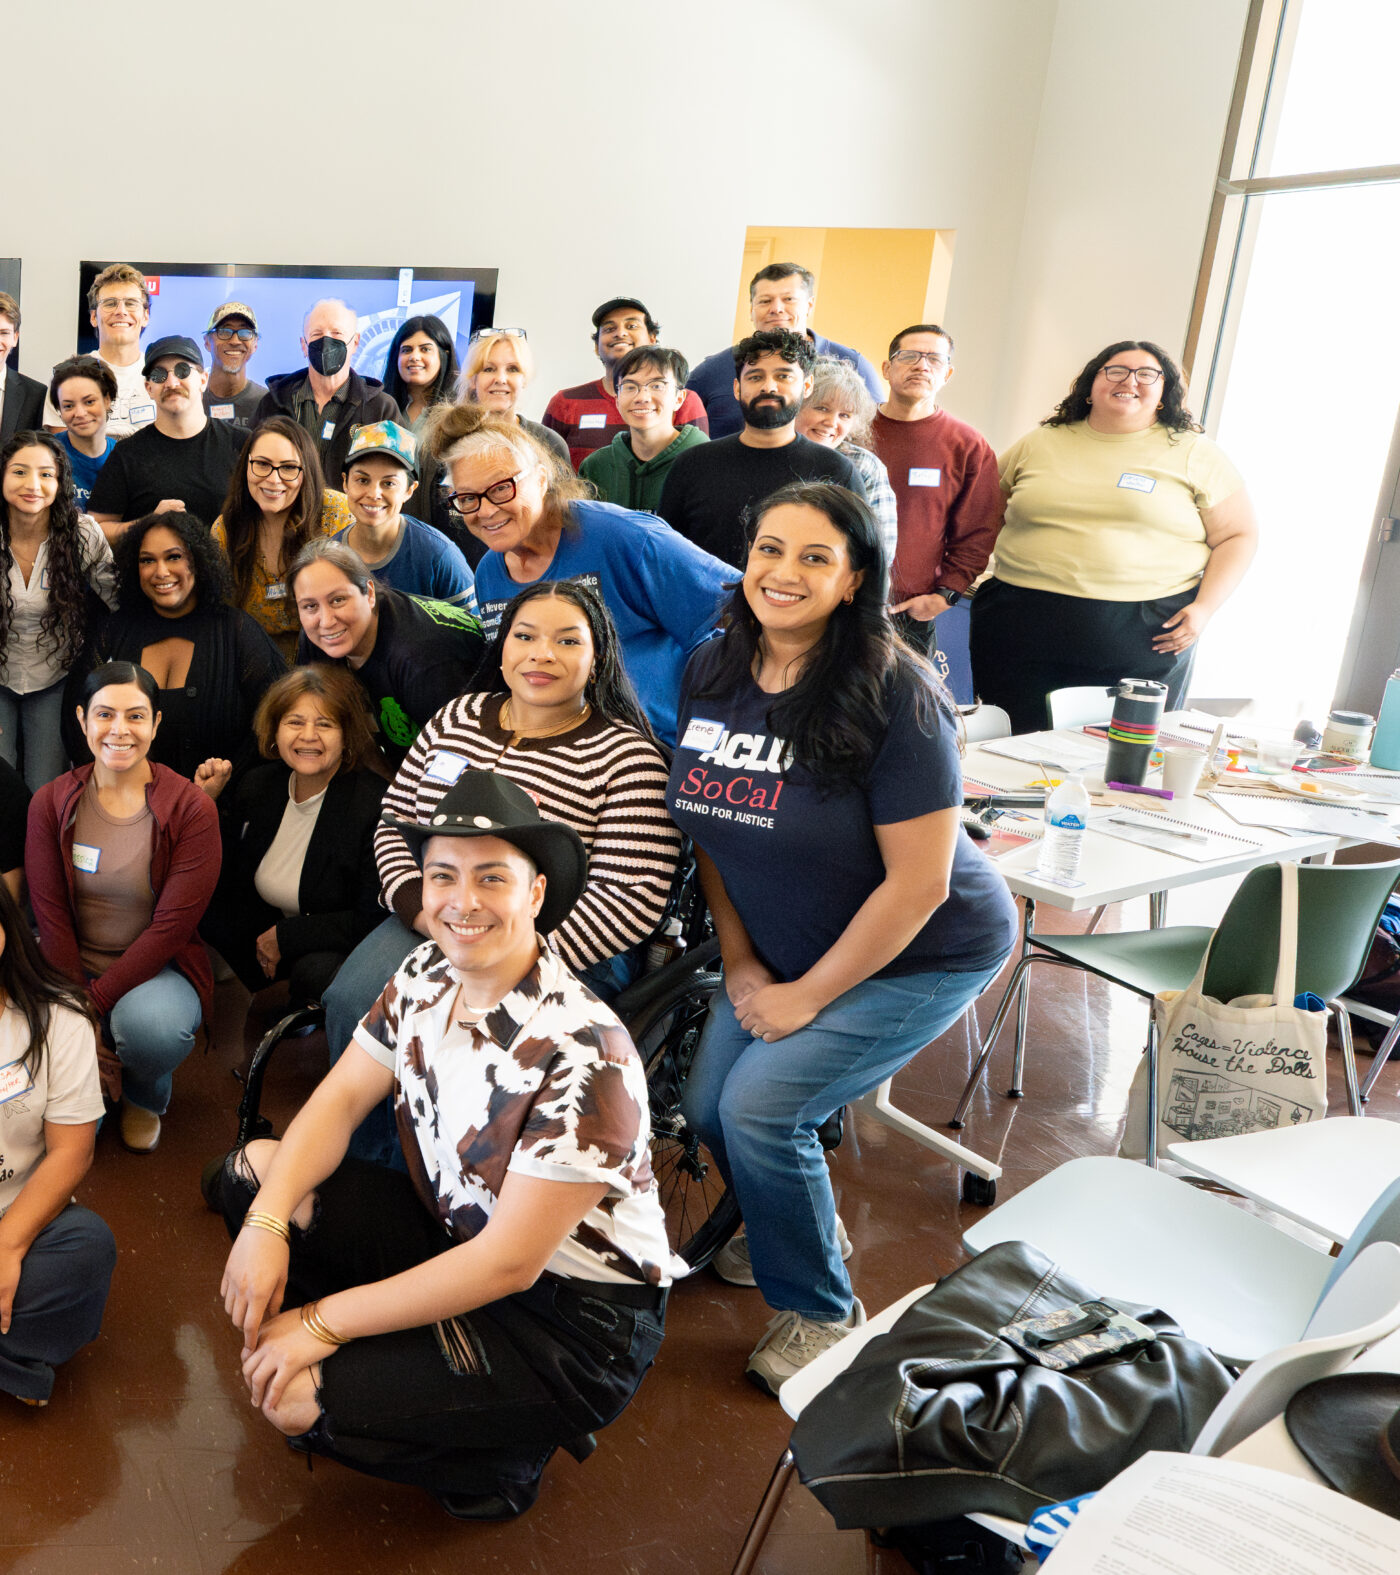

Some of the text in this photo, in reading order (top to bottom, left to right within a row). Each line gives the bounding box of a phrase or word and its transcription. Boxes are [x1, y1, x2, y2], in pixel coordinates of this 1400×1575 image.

[686, 720, 715, 735] Irene
[697, 729, 795, 774] ACLU
[678, 767, 784, 811] SoCal
[675, 798, 775, 829] STAND FOR JUSTICE
[1171, 1037, 1317, 1080] House the Dolls
[1181, 1022, 1221, 1049] Cages
[1232, 1037, 1313, 1061] Violence
